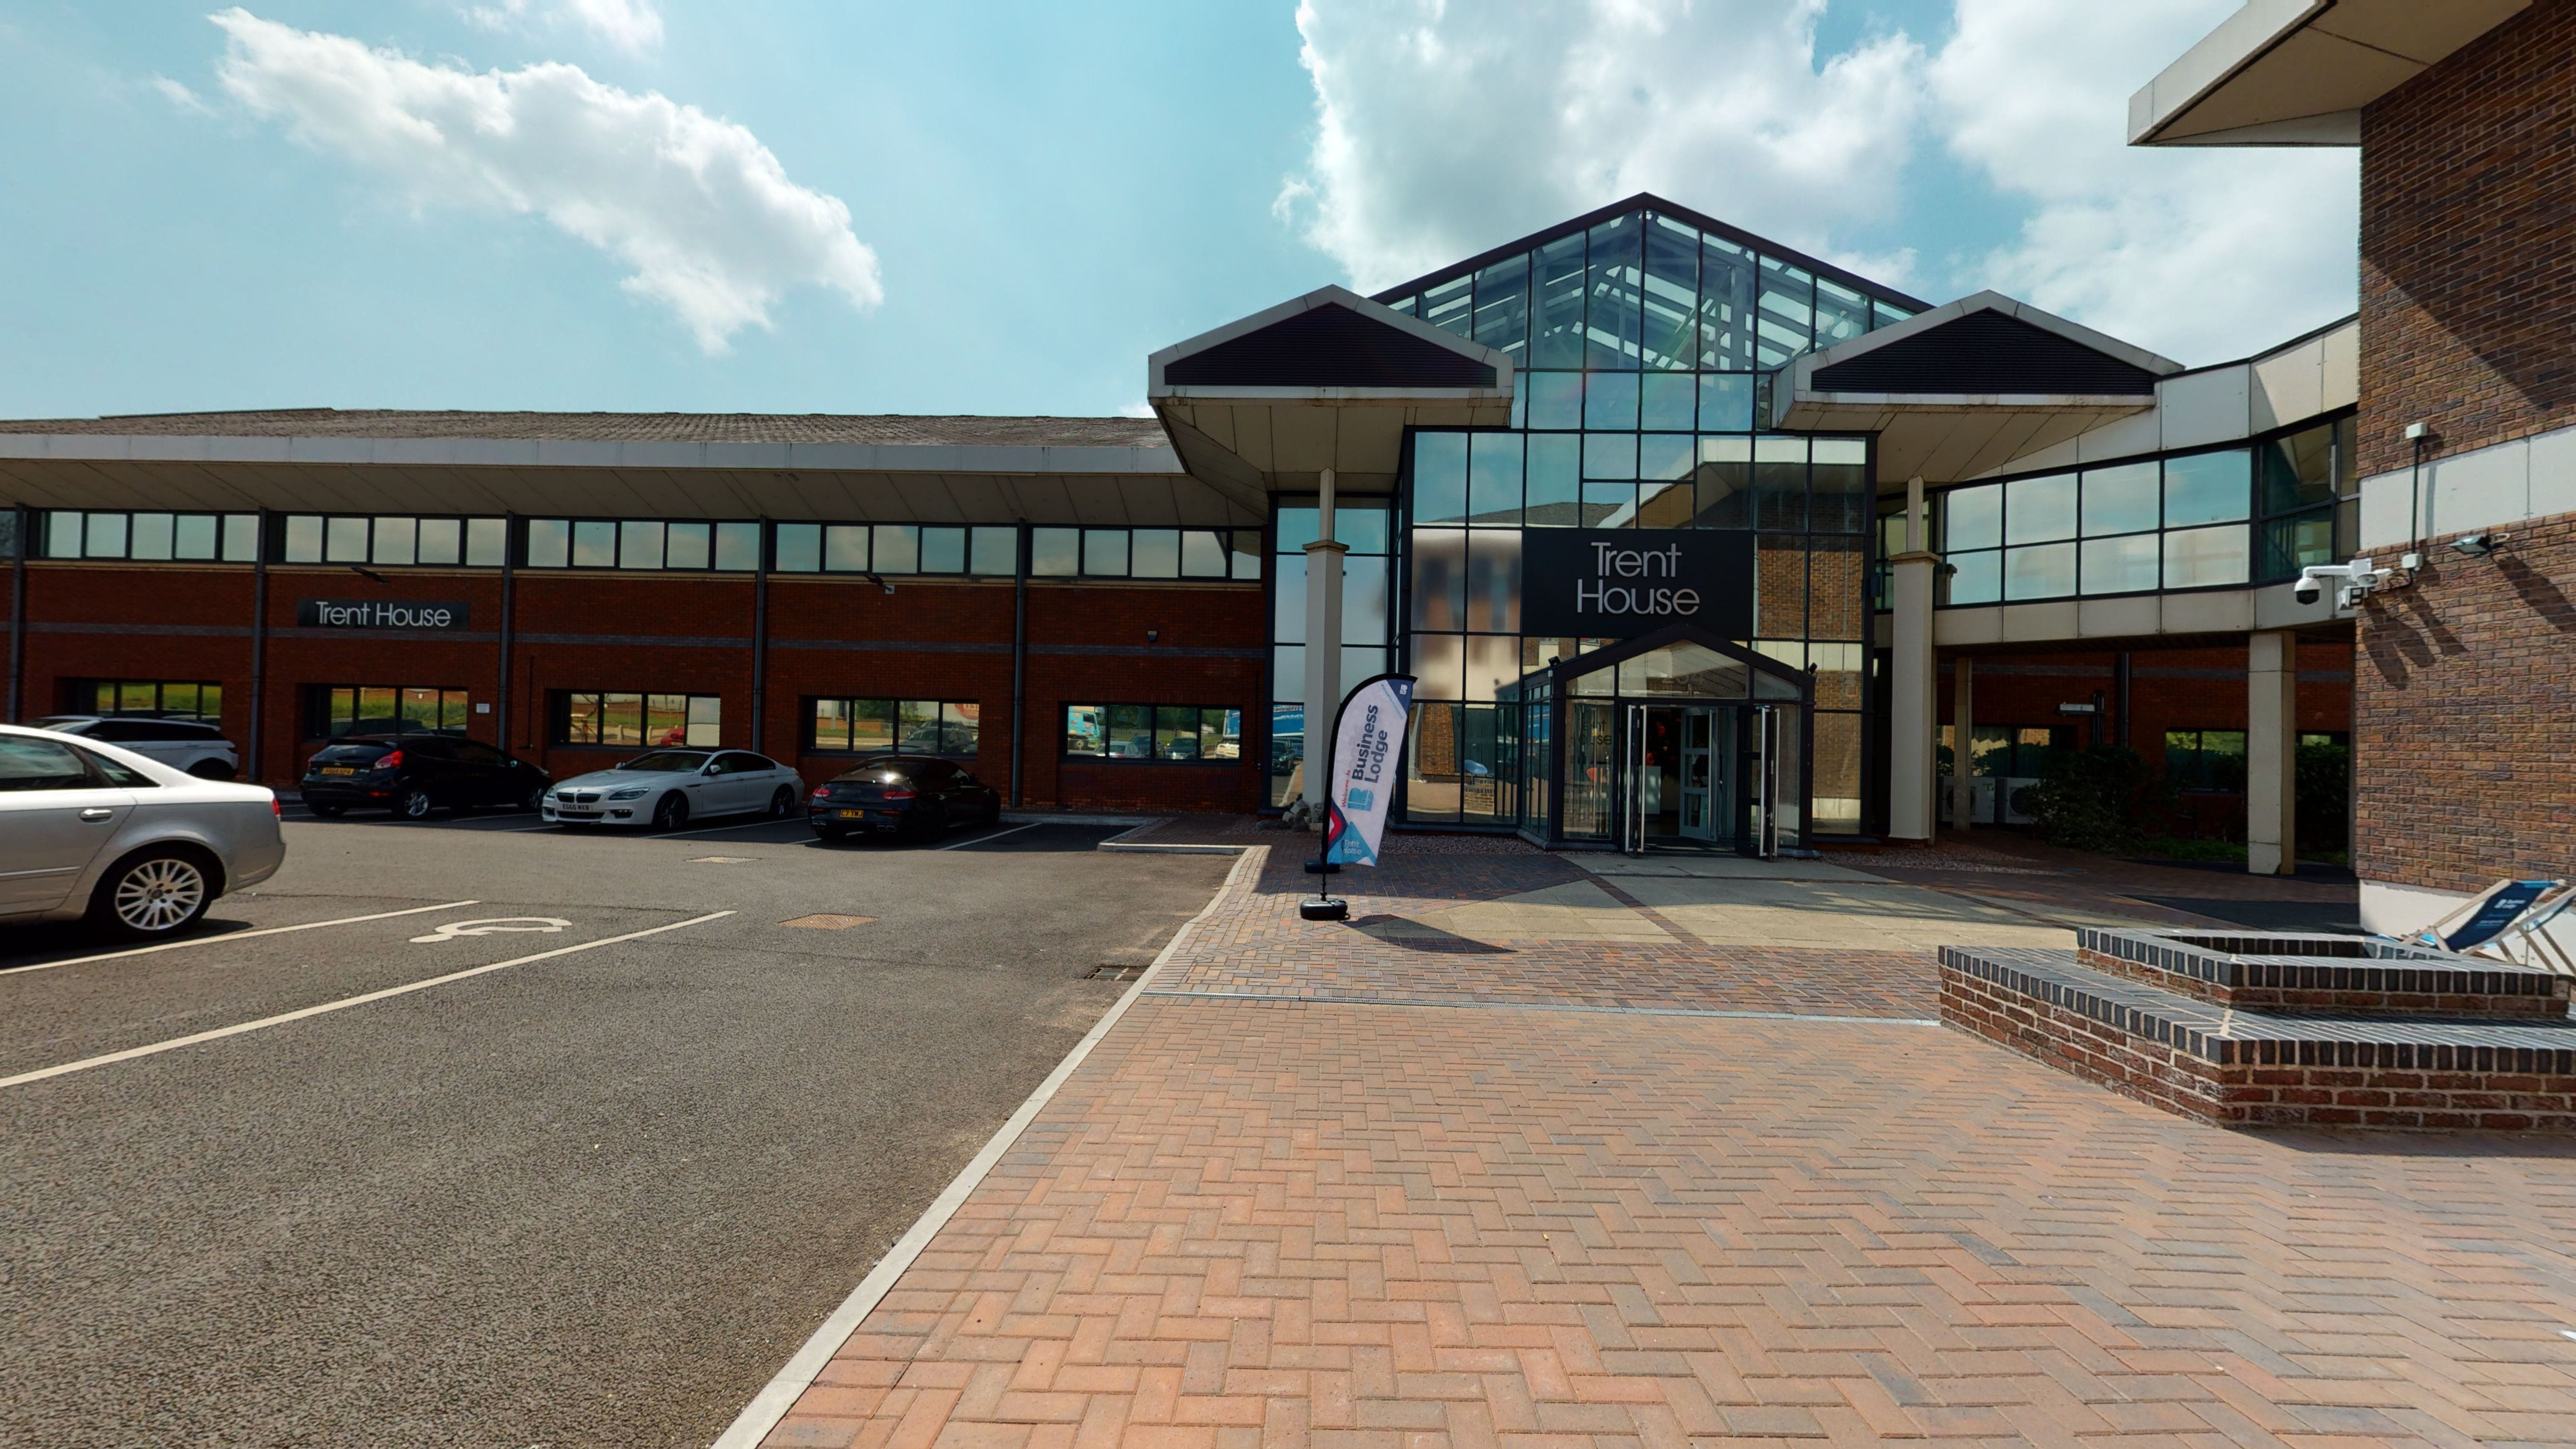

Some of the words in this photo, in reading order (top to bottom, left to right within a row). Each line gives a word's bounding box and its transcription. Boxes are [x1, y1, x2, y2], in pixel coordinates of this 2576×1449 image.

[1591, 542, 1682, 577] Trent
[315, 601, 371, 625] Trent
[376, 603, 451, 627] House
[1577, 579, 1700, 615] House
[1352, 704, 1378, 780] Business
[1364, 729, 1388, 783] Lodge
[1341, 779, 1349, 807] Welcome
[1344, 839, 1360, 848] Trnt
